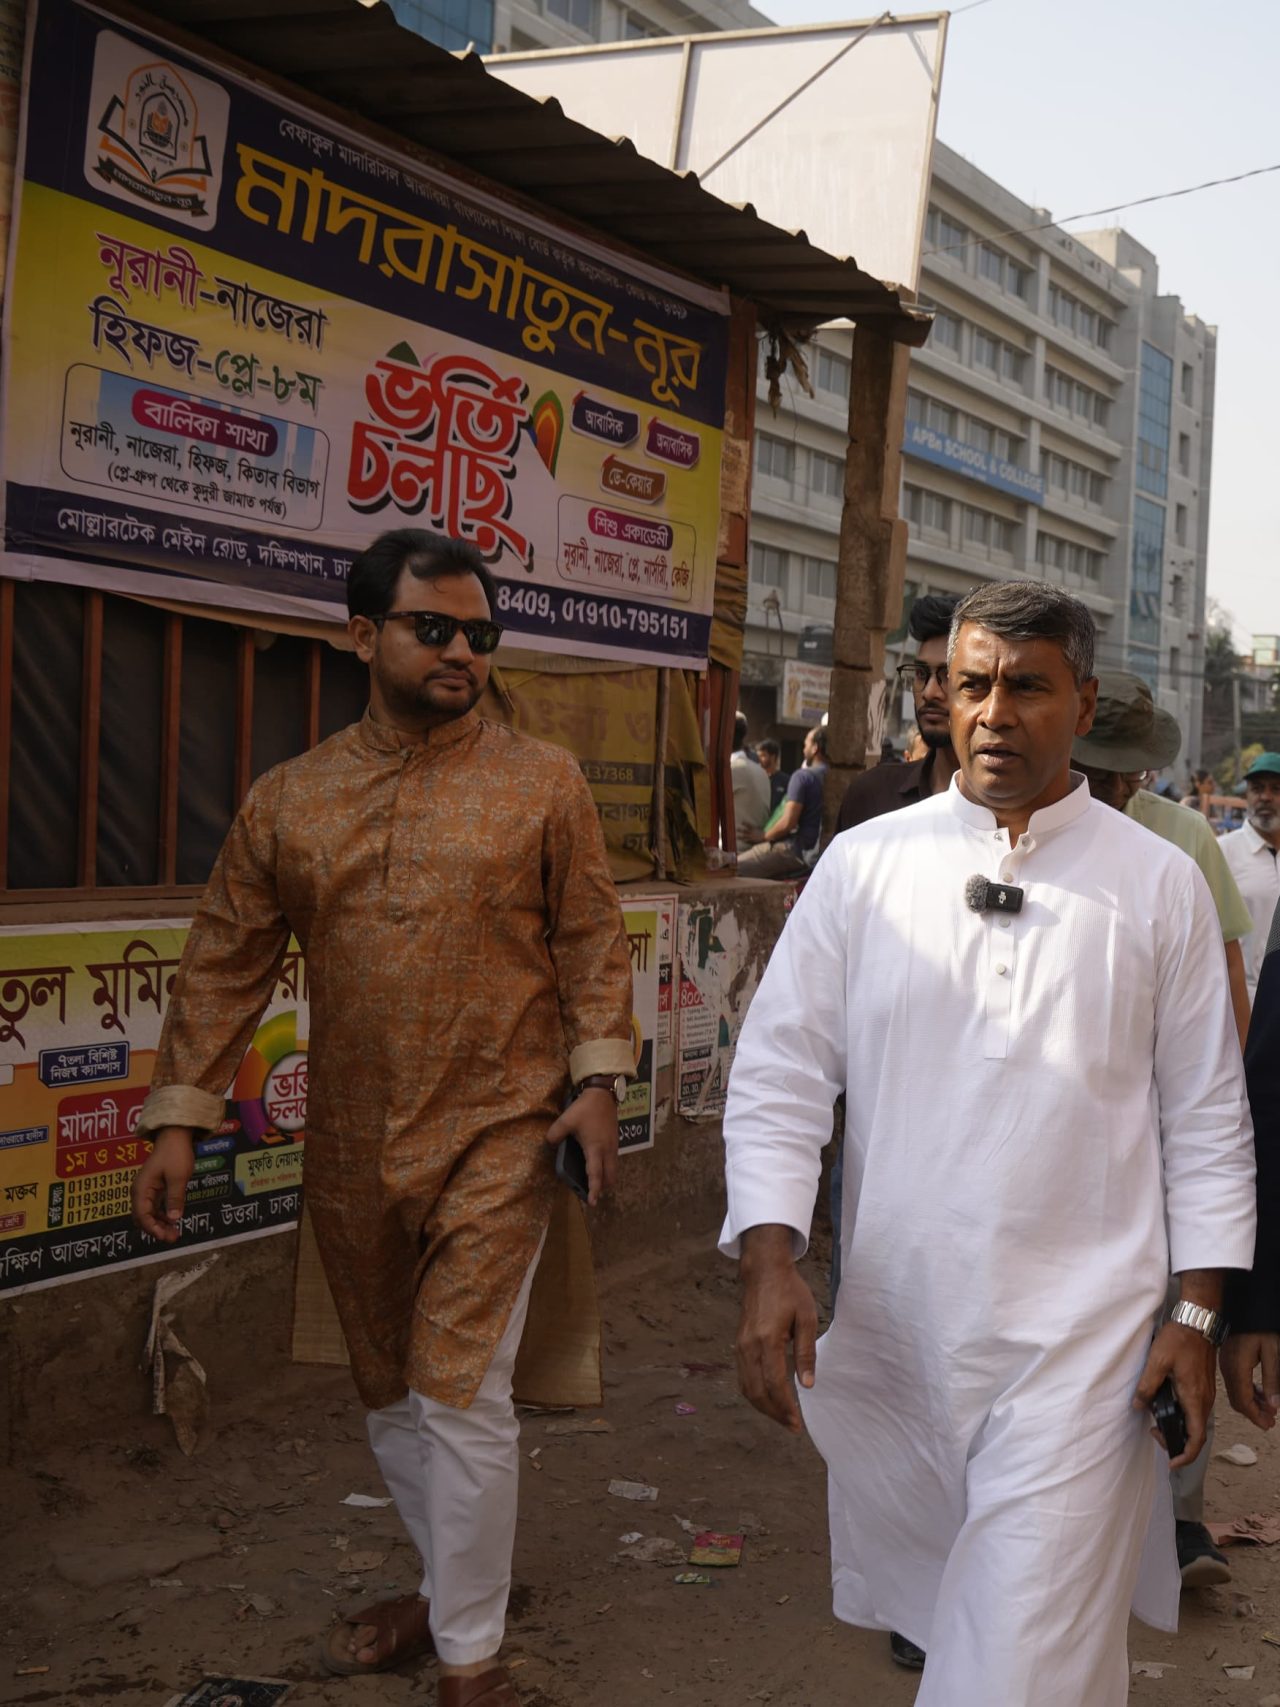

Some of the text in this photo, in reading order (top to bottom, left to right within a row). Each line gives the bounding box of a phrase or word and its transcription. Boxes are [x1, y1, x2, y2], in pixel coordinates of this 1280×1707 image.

[279, 119, 334, 158] বেফাকুল
[338, 144, 400, 186] মাদারিসিল
[366, 355, 526, 454] ভর্তি
[585, 408, 624, 436] আবাসিক
[143, 400, 269, 451] বালিকা শাখা
[656, 433, 693, 459] অনাবাসিক
[912, 427, 943, 453] APBn
[944, 439, 987, 471] SCHOOL
[989, 459, 997, 475] &
[999, 462, 1044, 493] COLLEGE
[161, 475, 189, 495] থেকে
[223, 489, 255, 509] জামাত
[238, 459, 281, 488] কিতাব
[282, 469, 320, 499] বিভাগ
[347, 421, 526, 558] চলছে
[594, 510, 618, 537] শিশু
[57, 508, 155, 545] মোল্লারটেক
[162, 527, 206, 555] মেইন
[212, 540, 252, 568] রোড,
[257, 541, 329, 580] দক্ষিণখান,
[672, 561, 690, 588] কেজি
[562, 597, 688, 640] 01910-795151
[81, 1060, 120, 1077] ক্যাম্পাস
[87, 1047, 118, 1064] বিশিষ্ট
[59, 1098, 119, 1143] মাদানী
[64, 1151, 88, 1173] ১ম
[94, 1148, 108, 1165] ও
[115, 1140, 138, 1161] ২য়
[247, 1152, 274, 1177] মুফতি
[51, 1230, 133, 1264] আজমপুর,
[220, 1201, 263, 1226] উত্তরা,
